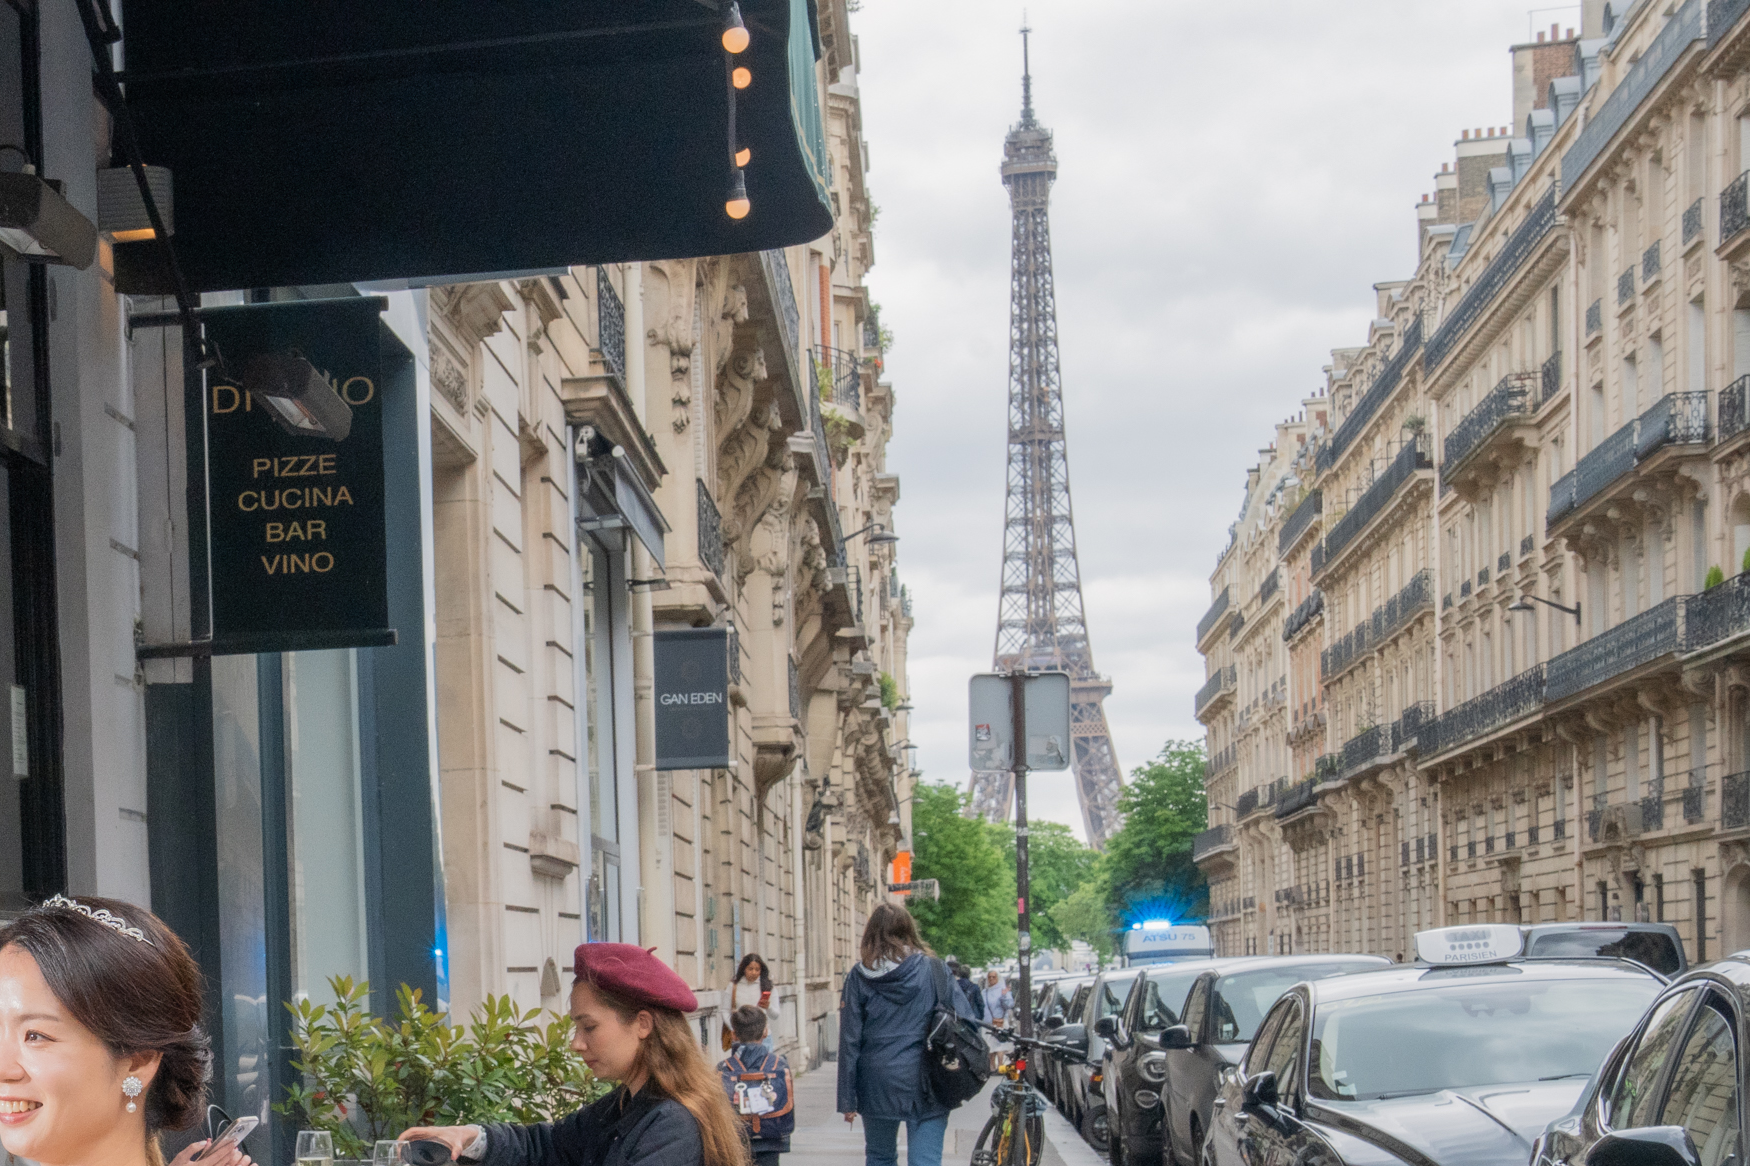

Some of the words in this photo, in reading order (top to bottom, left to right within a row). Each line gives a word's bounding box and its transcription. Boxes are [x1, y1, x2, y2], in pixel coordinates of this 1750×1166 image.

[253, 454, 337, 479] PIZZE
[238, 486, 353, 511] CUCINA
[266, 520, 326, 543] BAR
[261, 552, 334, 575] VINO
[660, 693, 688, 705] GAN
[690, 692, 722, 704] EDEN
[1143, 933, 1177, 943] ATSU
[1449, 930, 1486, 941] TAXI
[1445, 951, 1497, 961] PARISIEN
